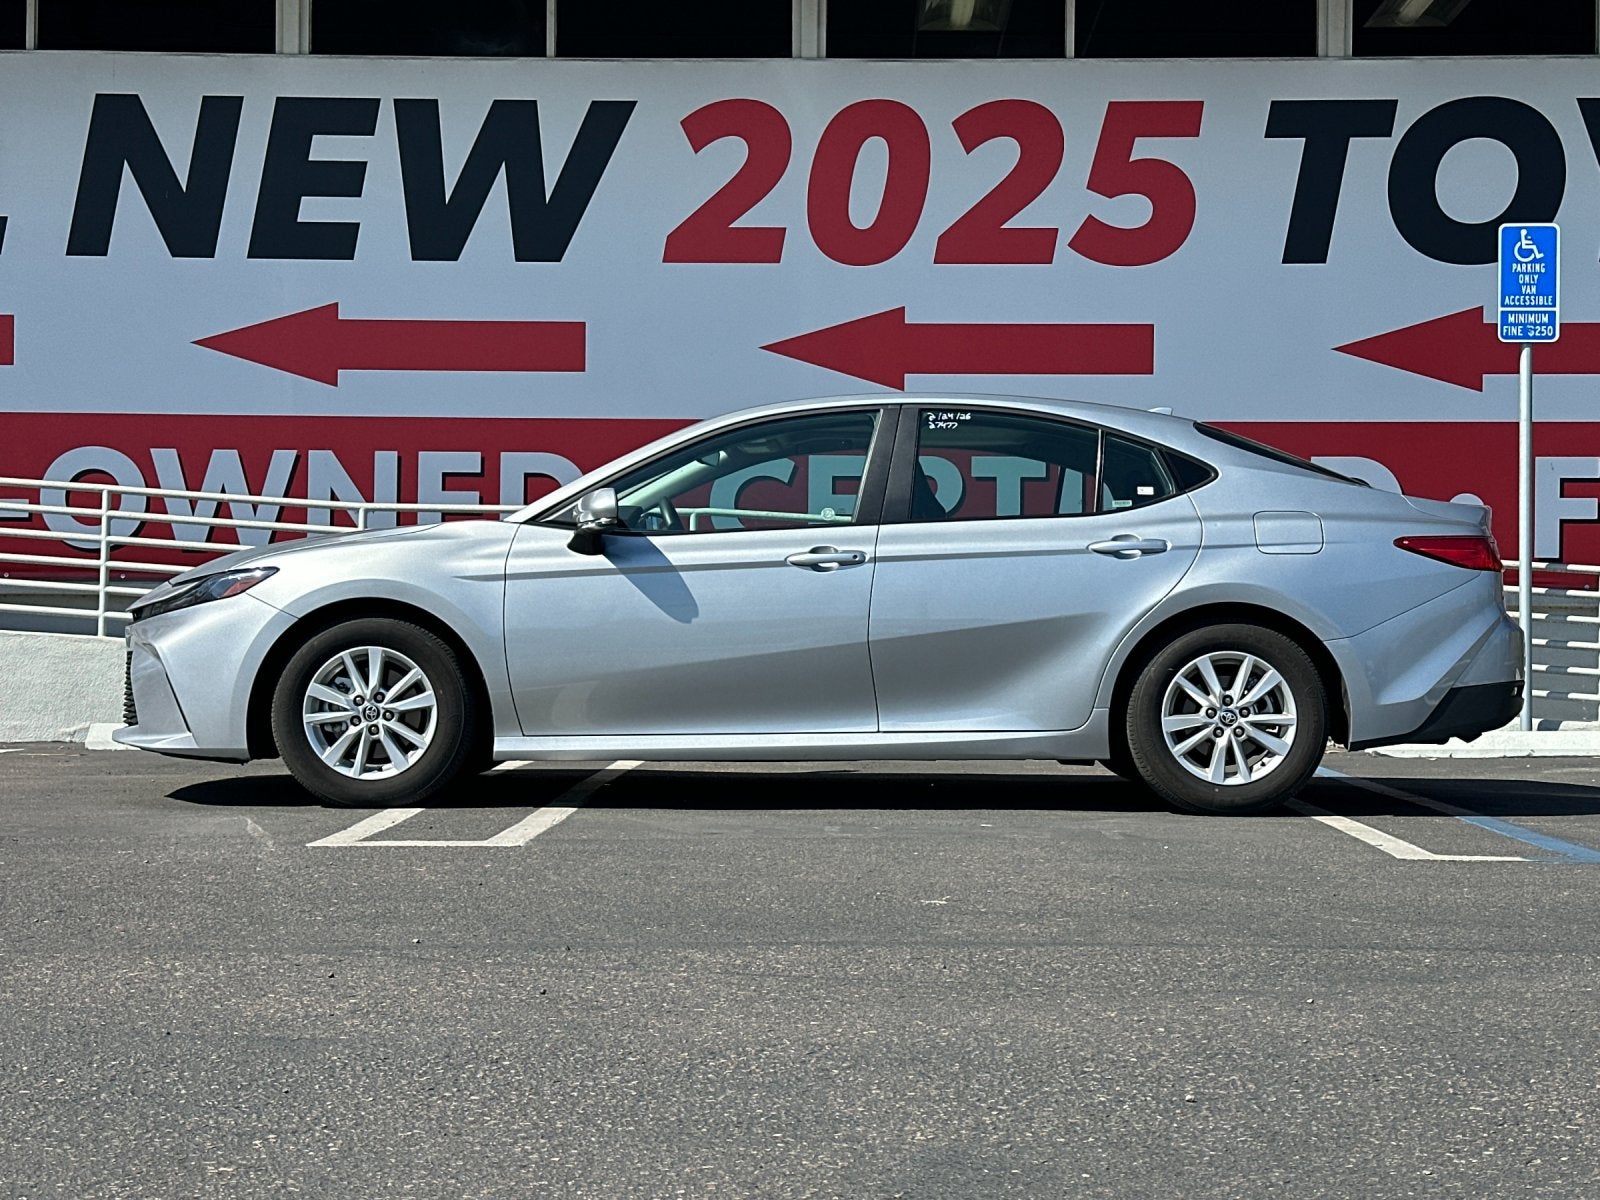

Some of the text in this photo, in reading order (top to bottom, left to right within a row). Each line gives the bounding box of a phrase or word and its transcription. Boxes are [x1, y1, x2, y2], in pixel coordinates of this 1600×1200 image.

[66, 93, 1600, 266] NEW 2025 TO
[1512, 263, 1545, 273] PARKING
[1518, 274, 1539, 284] ONLY
[1521, 285, 1536, 295] VAN
[1504, 296, 1553, 305] ACCESSIBLE
[1508, 313, 1549, 323] MINIMUM
[1502, 326, 1523, 336] FINE
